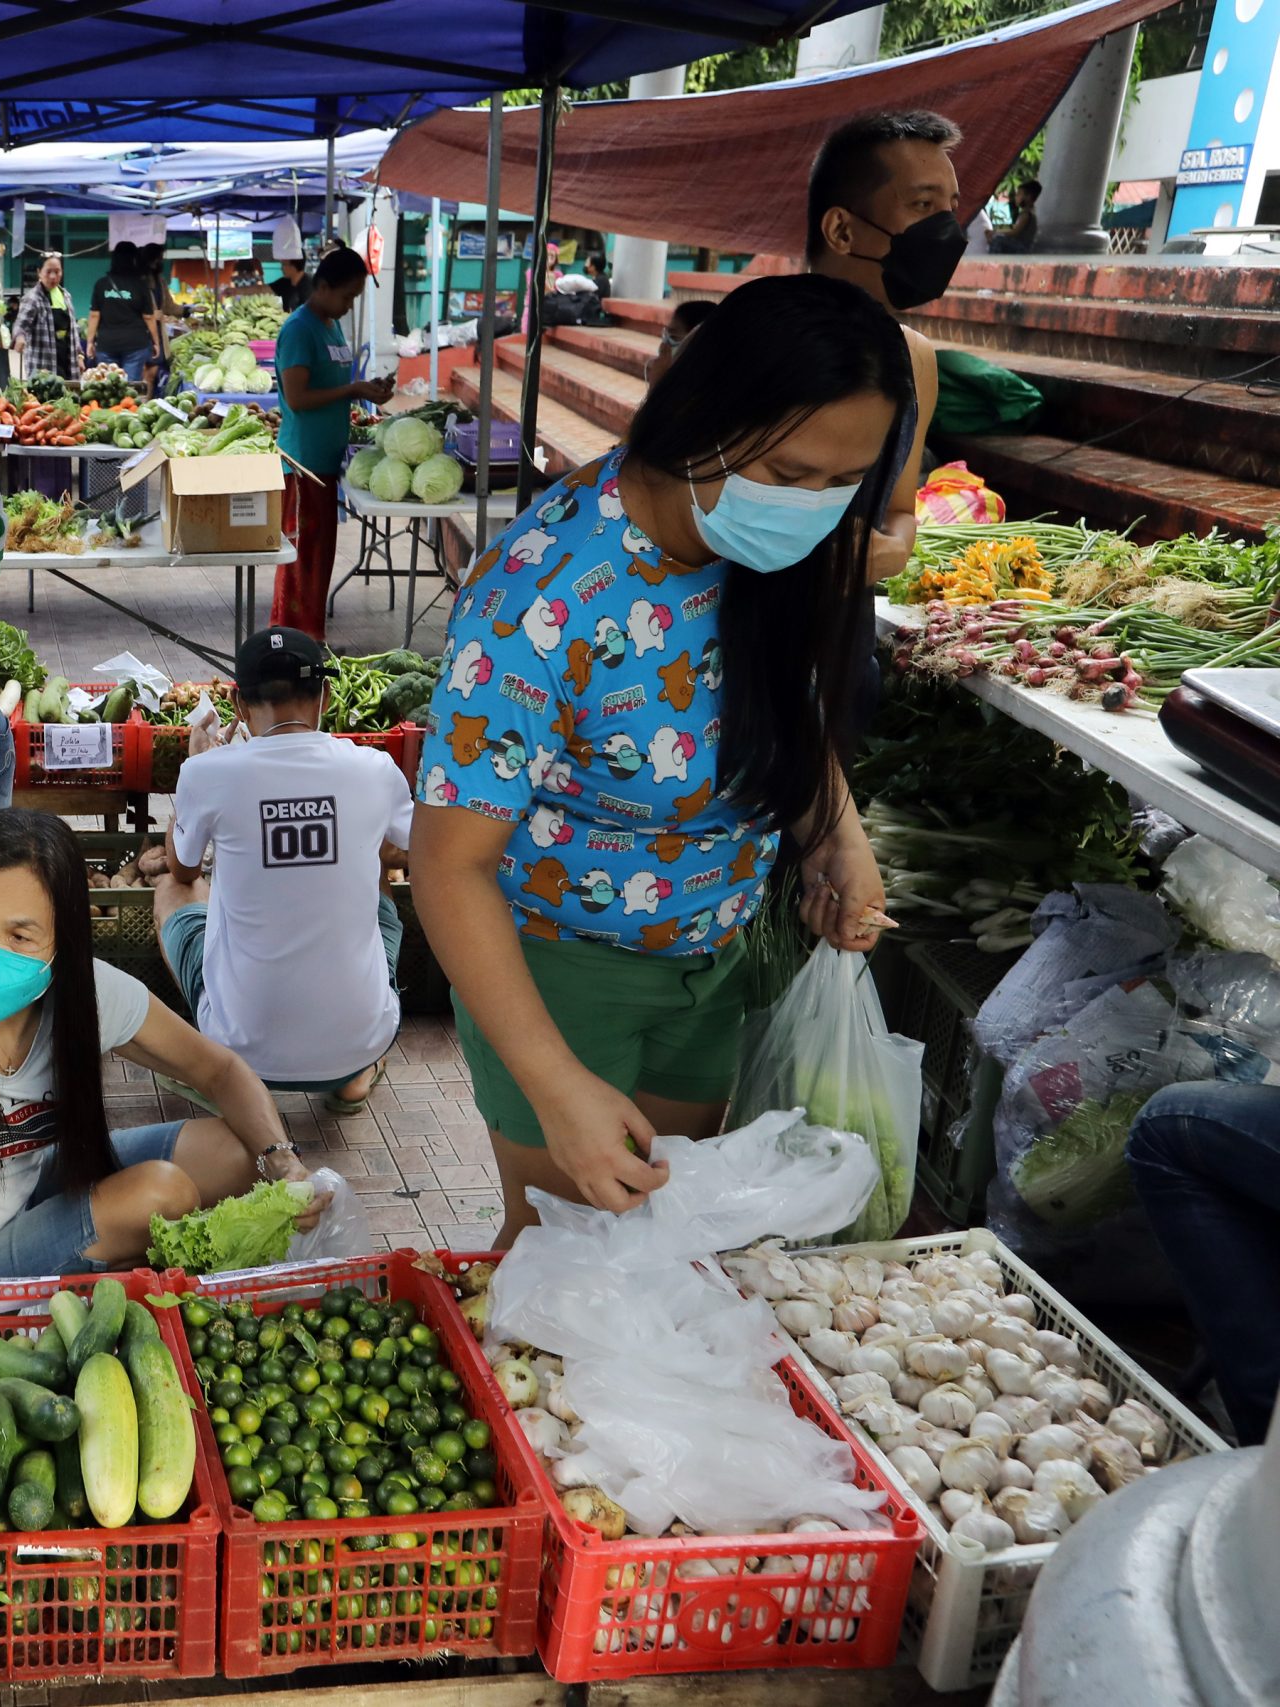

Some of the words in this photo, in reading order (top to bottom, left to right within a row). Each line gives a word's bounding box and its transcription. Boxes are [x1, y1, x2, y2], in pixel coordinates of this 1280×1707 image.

[501, 683, 546, 715] BEARS
[515, 678, 549, 704] BARE
[602, 686, 644, 707] BEARS
[601, 701, 634, 718] BARE
[262, 800, 335, 820] DEKRA
[482, 801, 513, 818] BARE
[271, 823, 329, 860] 00
[587, 840, 620, 852] BARE
[589, 831, 634, 843] BEARS
